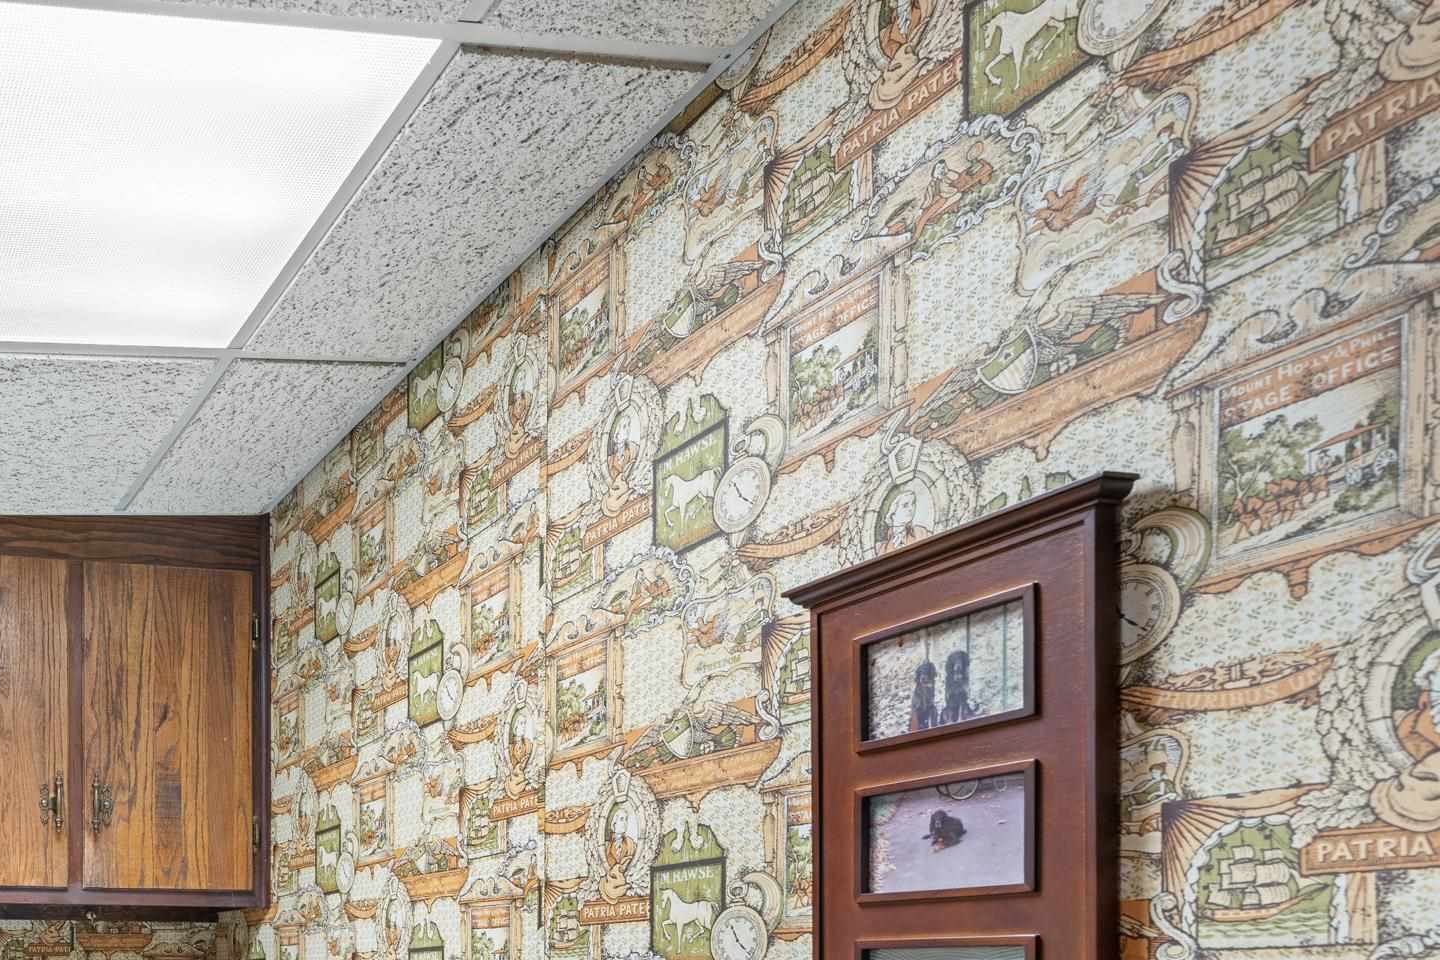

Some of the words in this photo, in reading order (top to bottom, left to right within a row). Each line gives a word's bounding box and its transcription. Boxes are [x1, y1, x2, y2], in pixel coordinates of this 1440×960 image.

[842, 108, 900, 157] PATRIA
[1326, 78, 1440, 151] PATRIA
[1312, 346, 1398, 389] OFFICE
[1317, 833, 1434, 862] PATRIA
[583, 904, 616, 919] PATRIA
